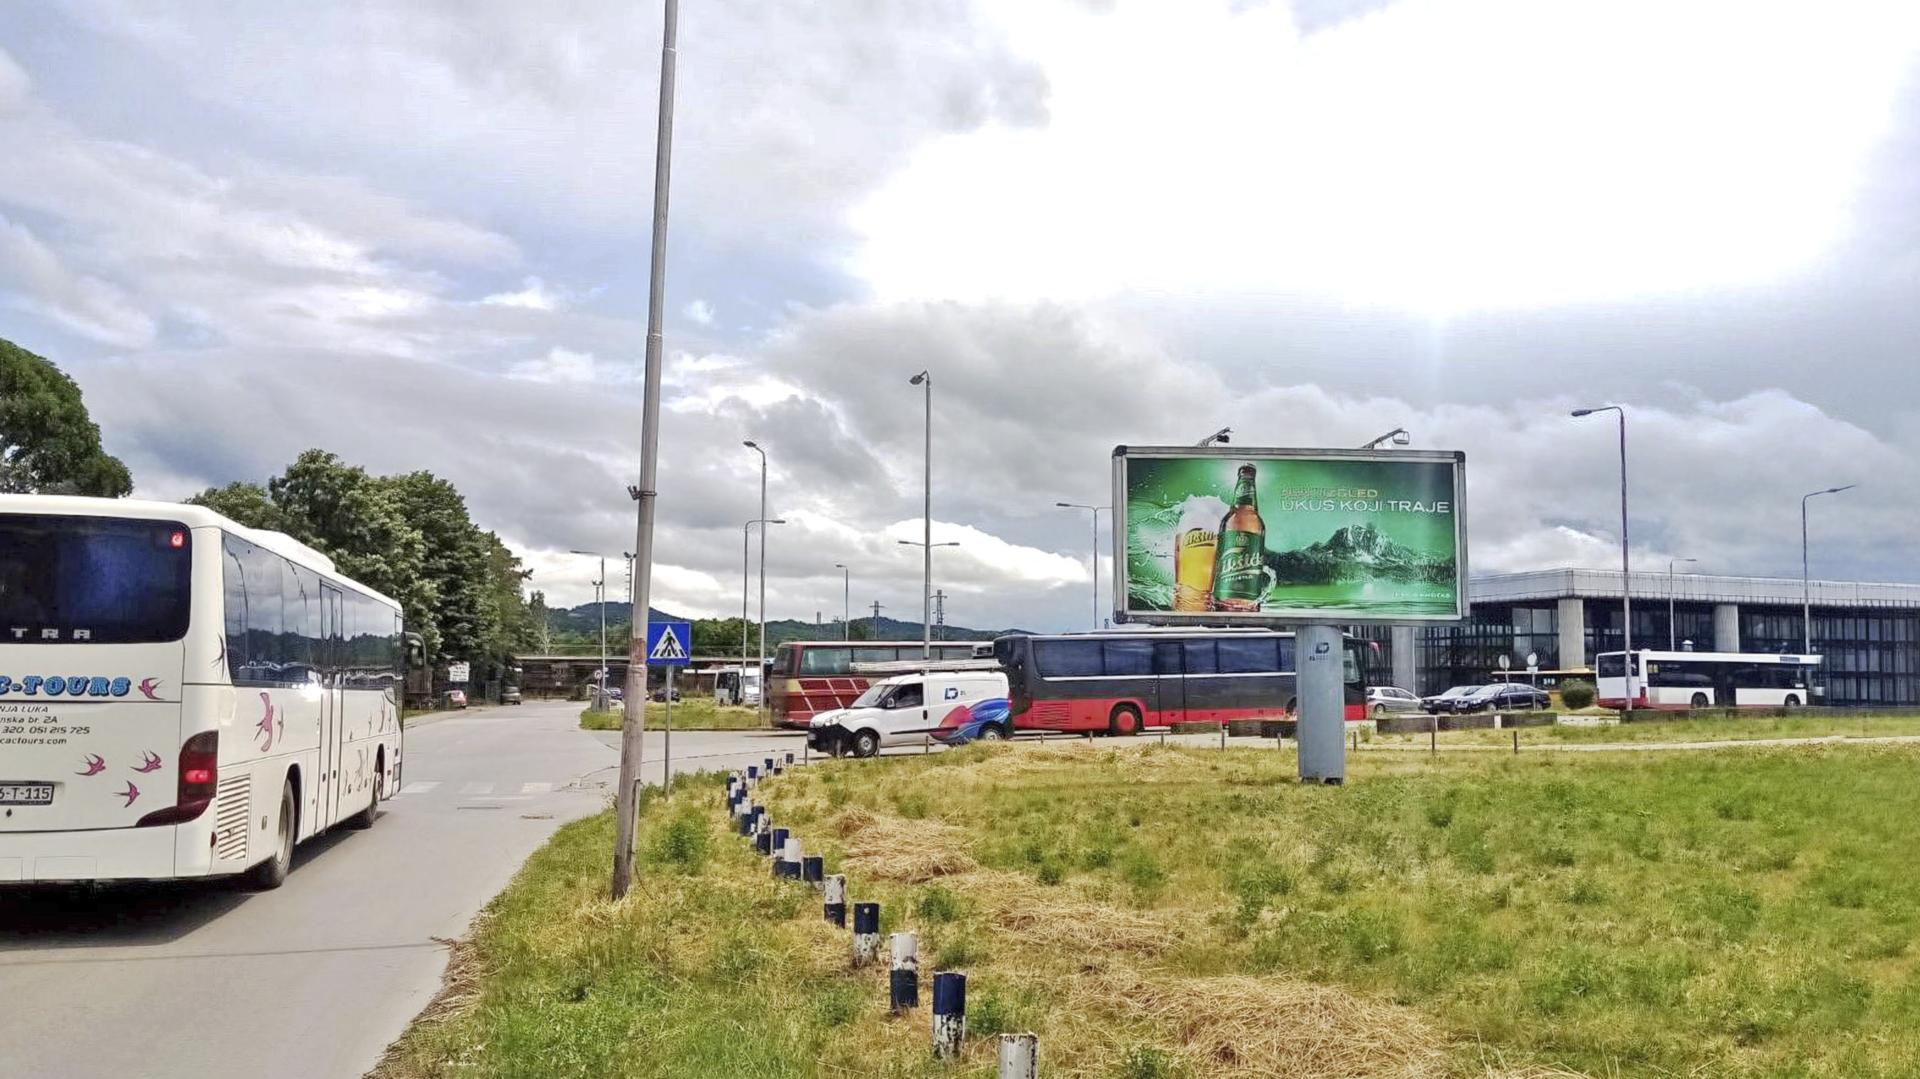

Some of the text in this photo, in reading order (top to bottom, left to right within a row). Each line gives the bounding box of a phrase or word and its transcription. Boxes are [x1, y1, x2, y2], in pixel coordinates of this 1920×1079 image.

[1281, 500, 1450, 513] UKUS KOJI TRAJE
[21, 705, 49, 713] LUKA
[43, 715, 58, 724] 2A
[29, 725, 48, 734] 051
[69, 726, 91, 735] 725
